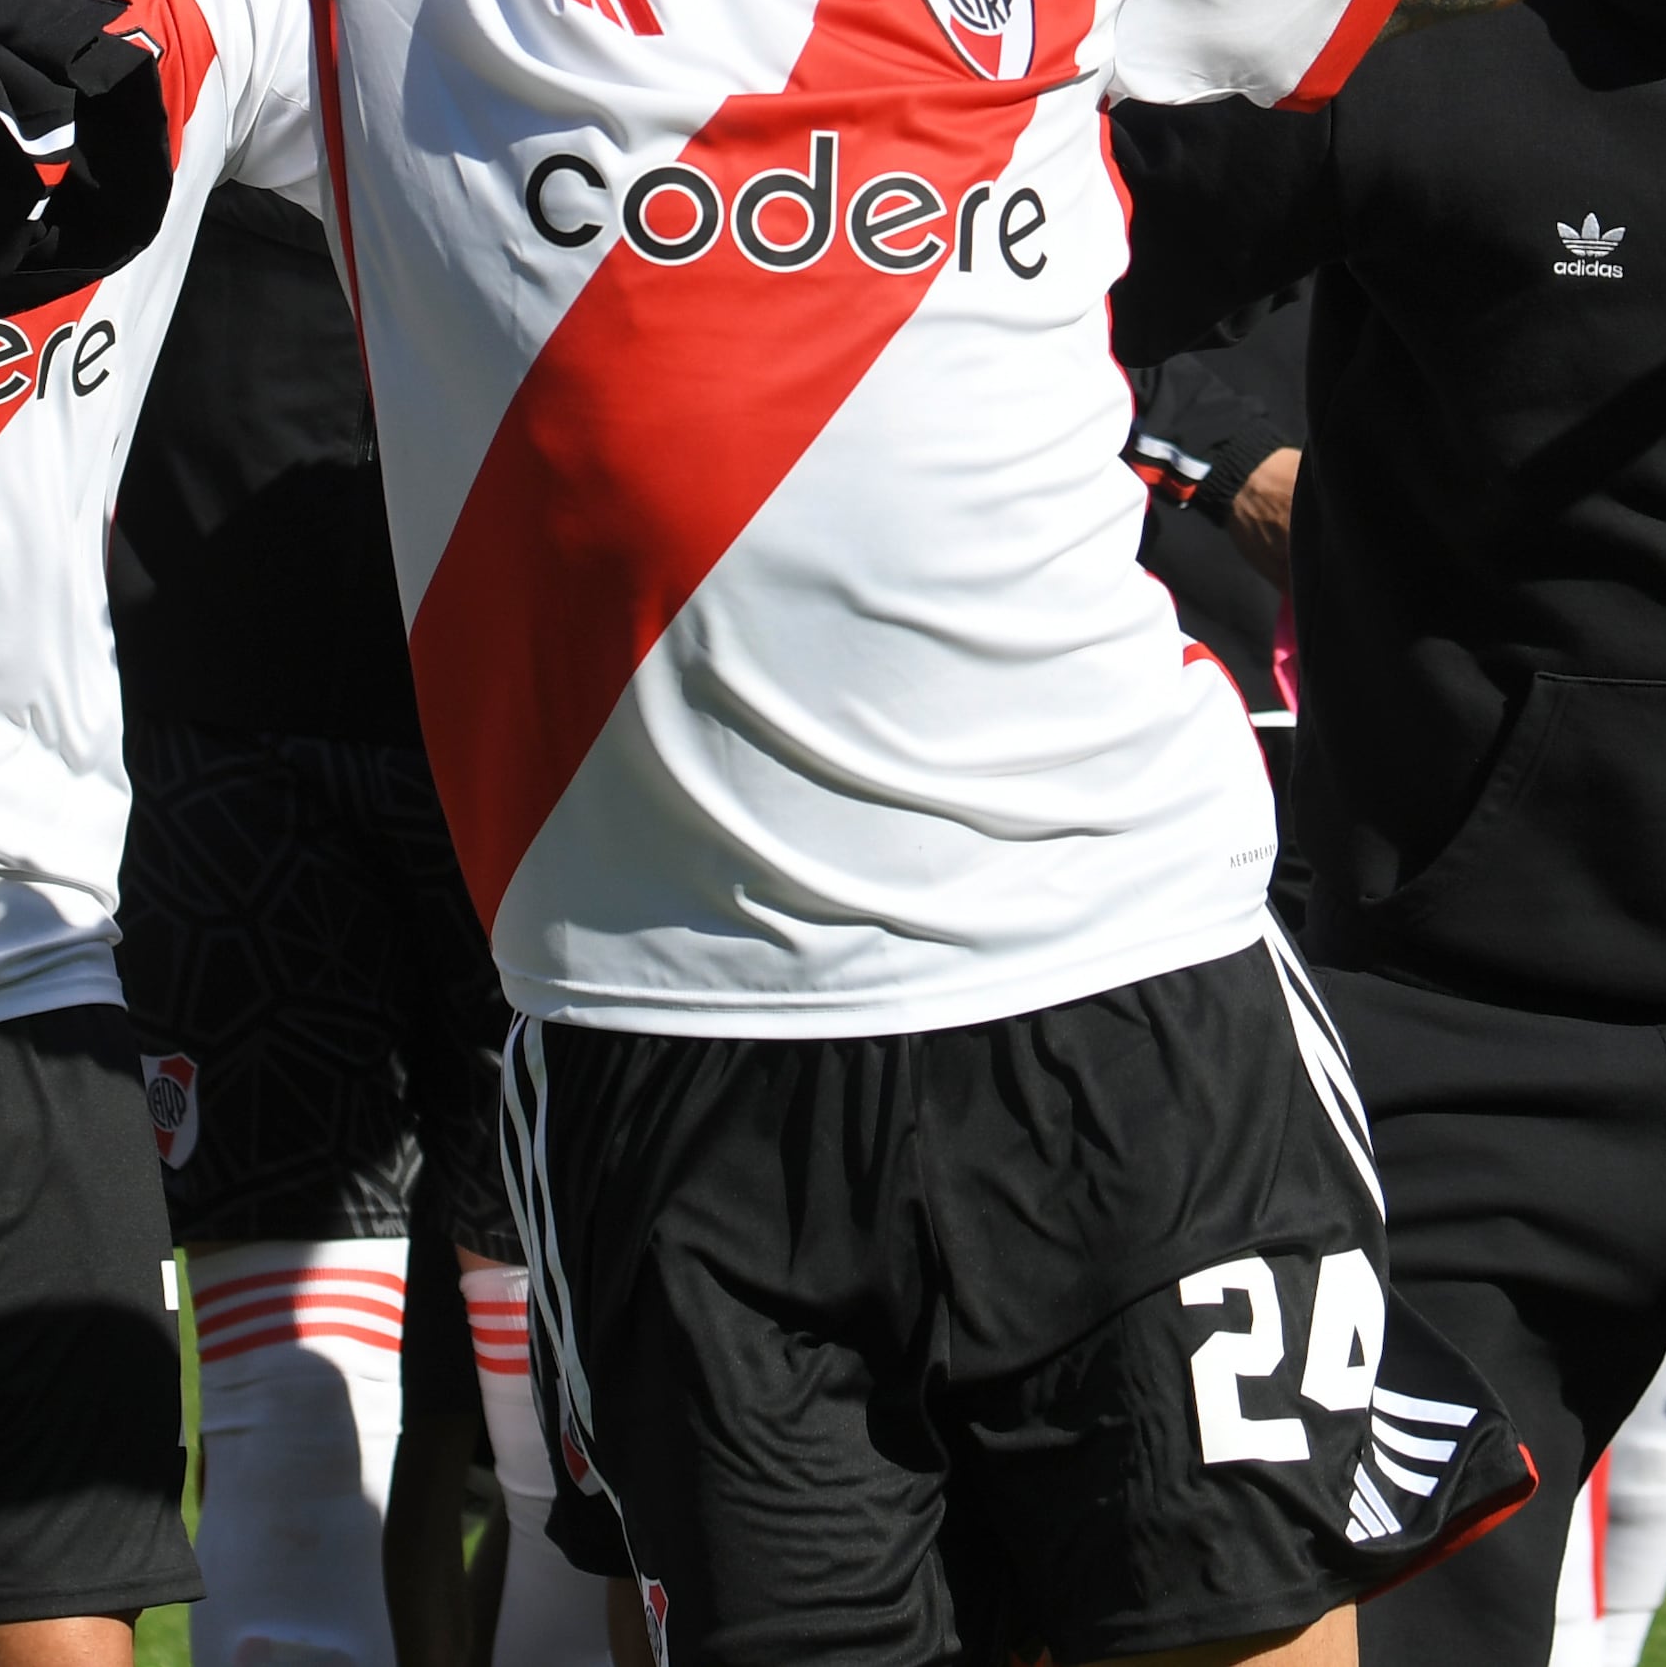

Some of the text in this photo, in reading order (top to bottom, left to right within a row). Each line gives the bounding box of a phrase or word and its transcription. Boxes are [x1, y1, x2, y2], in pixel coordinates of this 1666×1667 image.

[524, 130, 1049, 280] codere
[1552, 258, 1624, 280] adidas
[1178, 1246, 1388, 1466] 24
